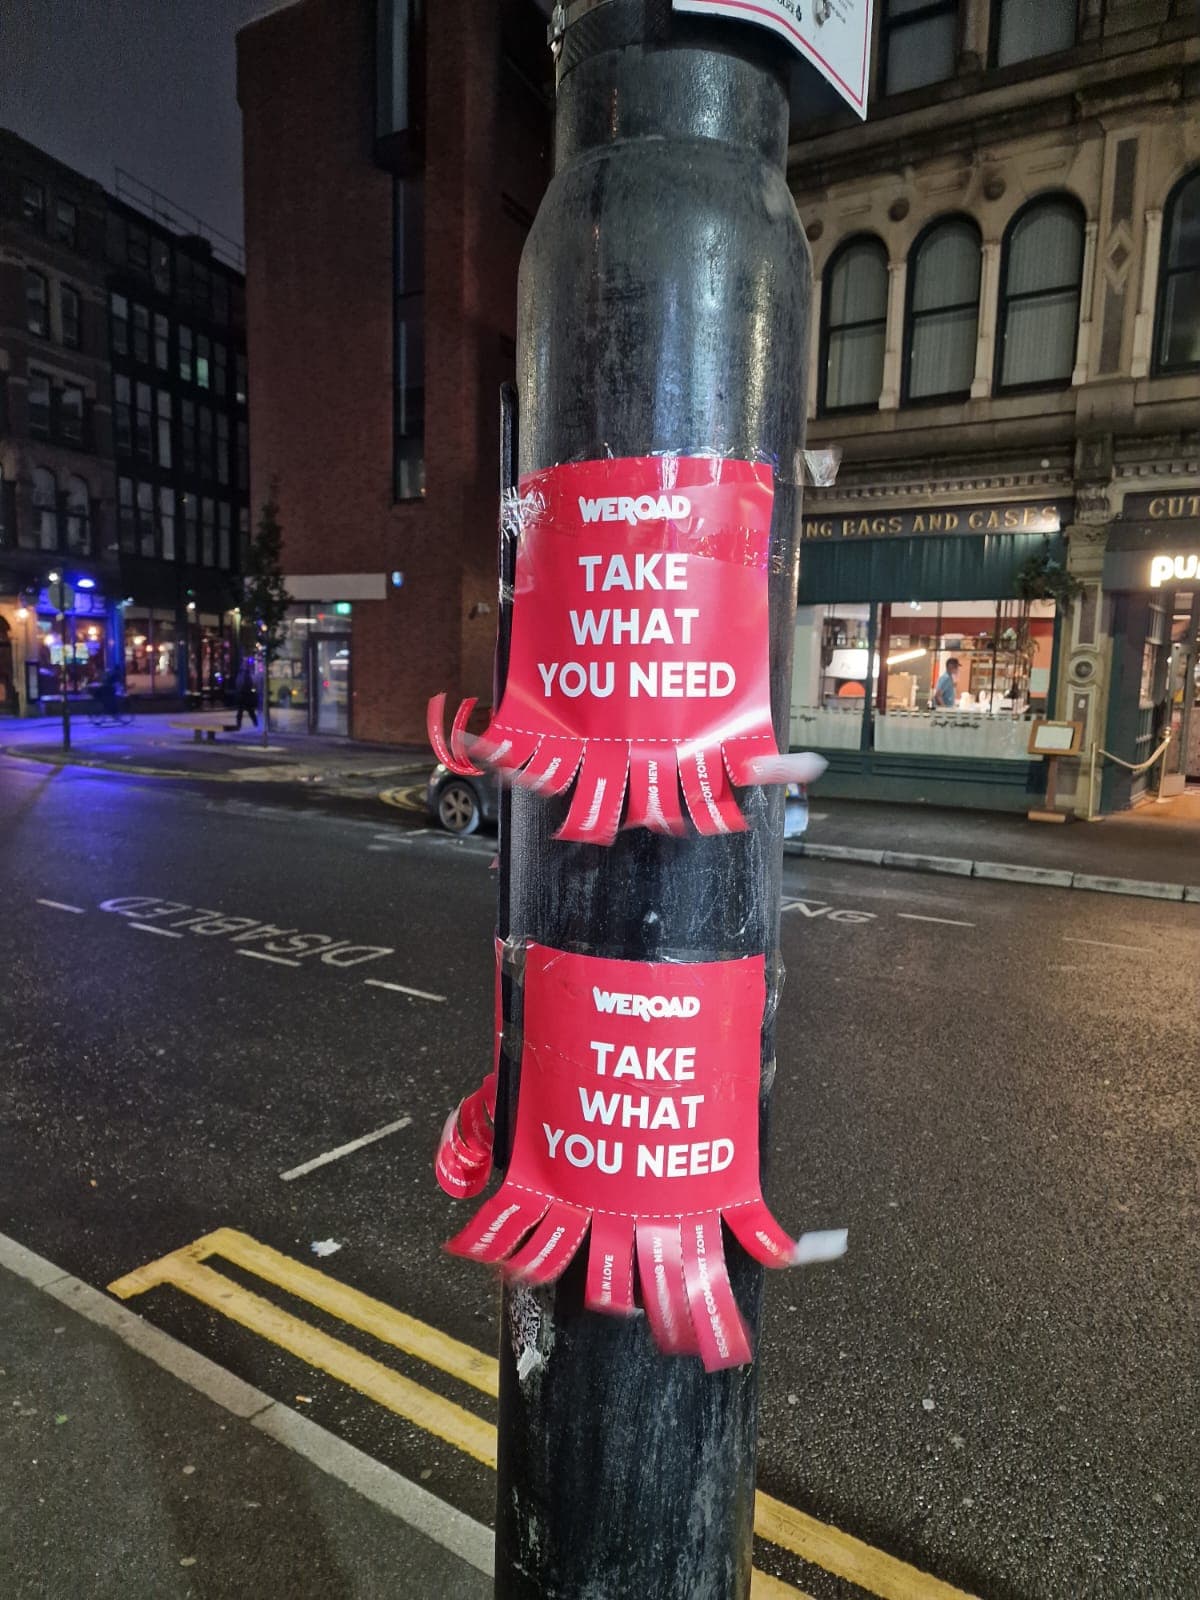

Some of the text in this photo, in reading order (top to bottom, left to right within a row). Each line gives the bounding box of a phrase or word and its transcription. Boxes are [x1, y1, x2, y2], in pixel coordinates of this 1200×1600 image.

[578, 495, 692, 526] WEROAD
[842, 517, 902, 536] BAGS
[912, 514, 959, 533] AND
[969, 506, 1056, 530] CASES
[578, 553, 689, 592] TAKE
[1150, 554, 1200, 588] pu
[569, 608, 699, 645] WHAT
[537, 661, 736, 698] YOU NEED
[100, 897, 395, 967] DISABLED
[592, 986, 700, 1022] WEROAD
[590, 1041, 696, 1081] TAKE
[578, 1087, 705, 1130] WHAT
[542, 1122, 623, 1175] YOU
[637, 1138, 735, 1178] NEED
[602, 1254, 614, 1281] LOVE
[653, 1236, 664, 1263] NEW
[695, 1223, 729, 1359] ESCAPE COMFORT ZONE
